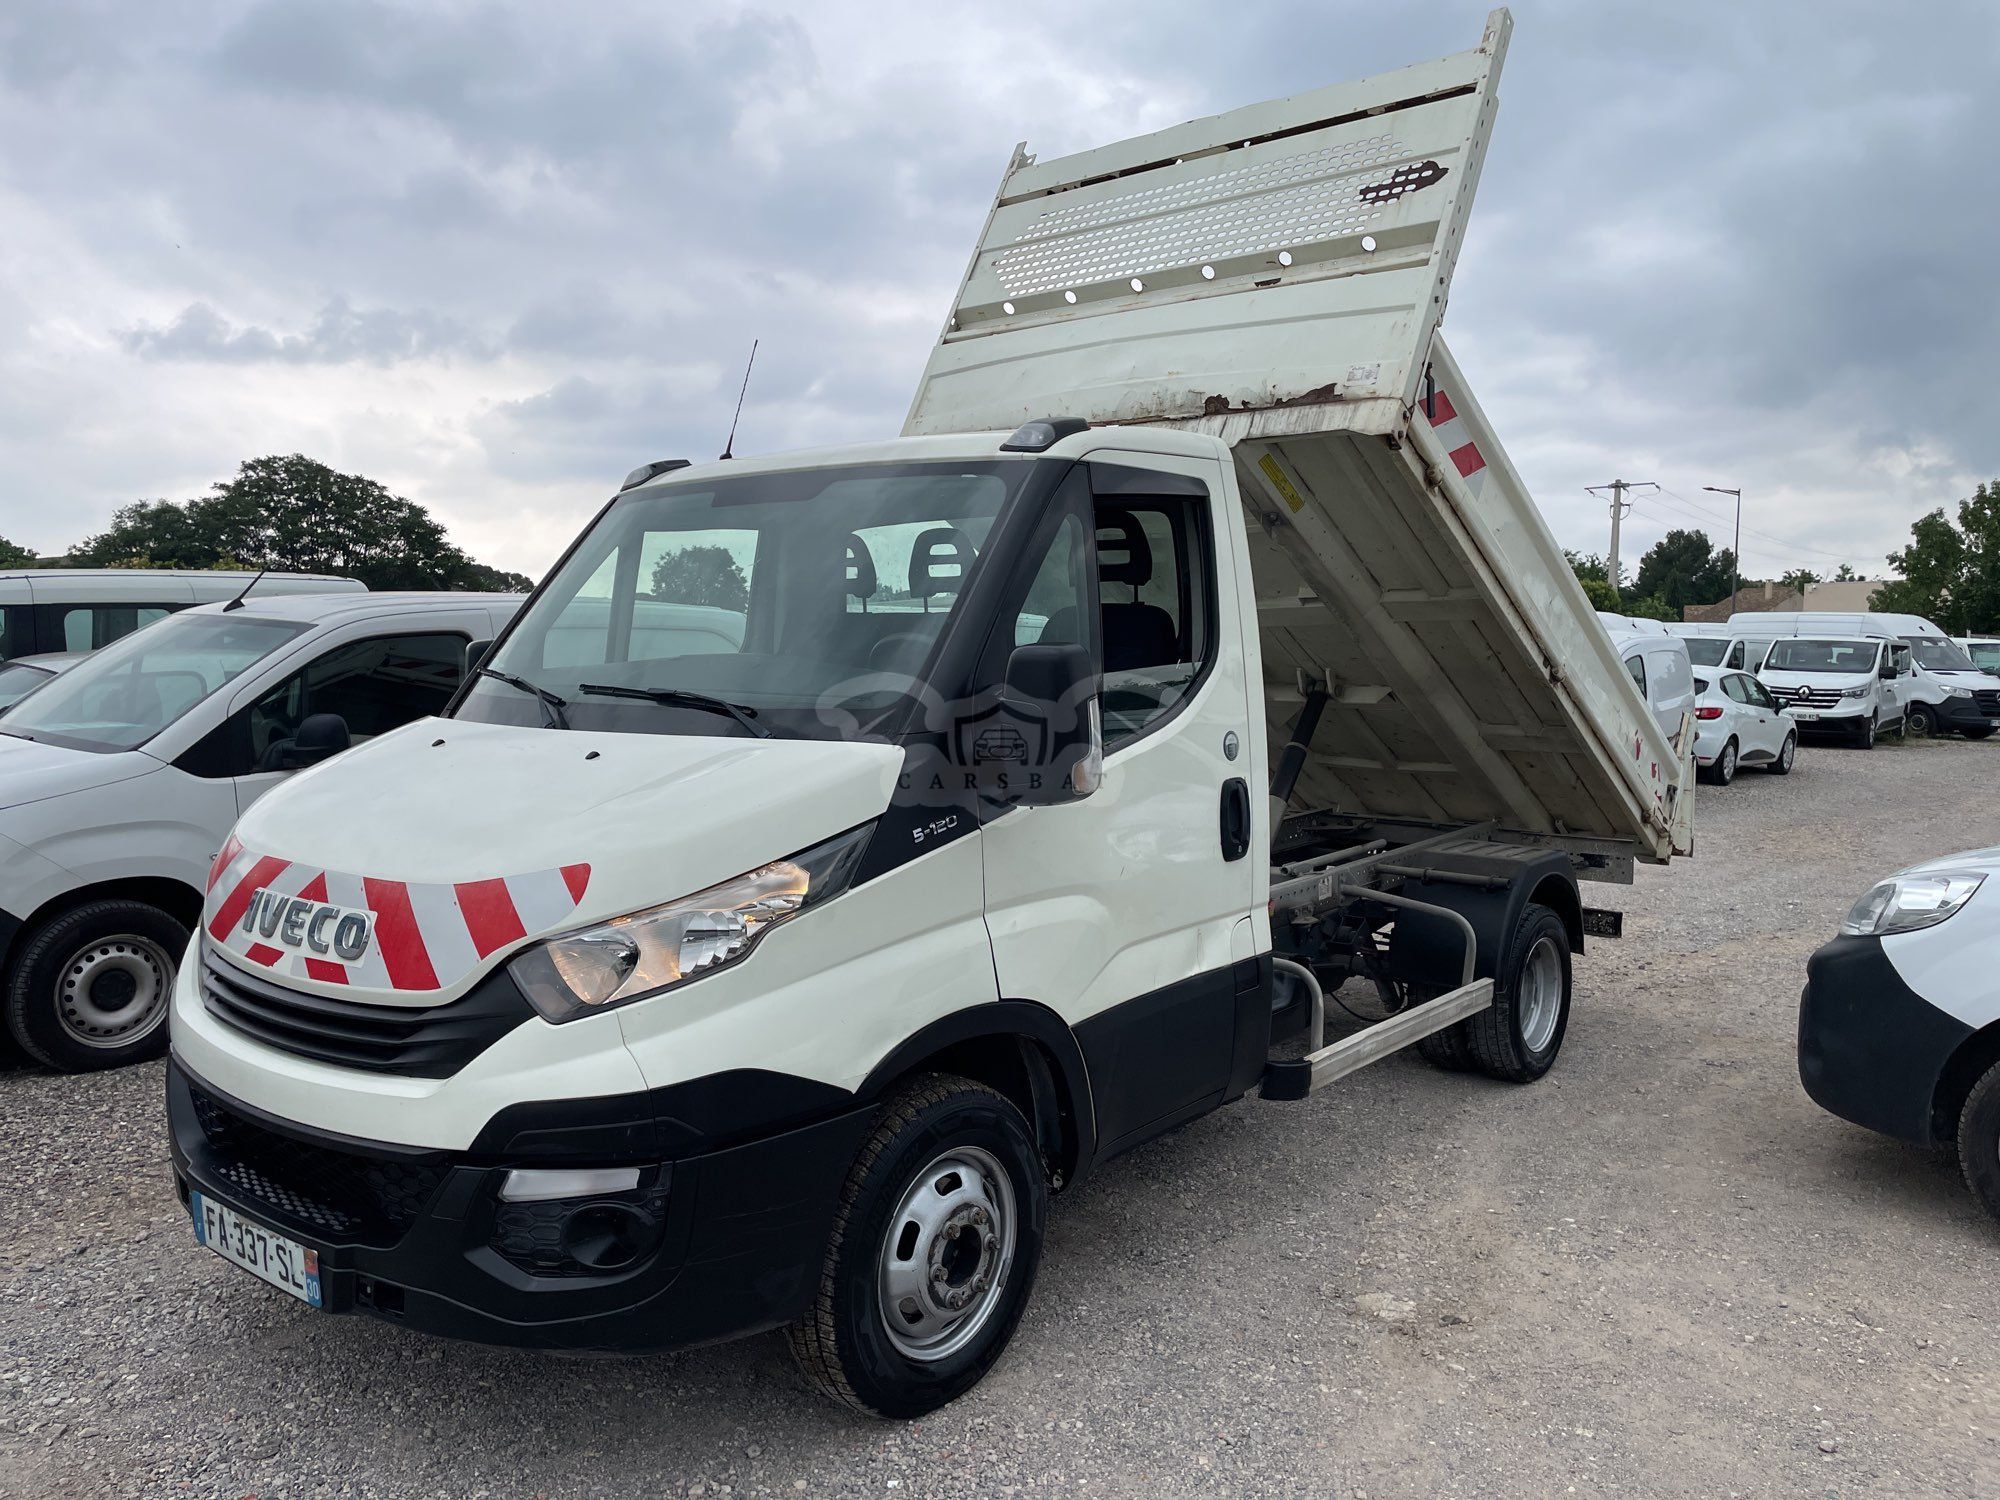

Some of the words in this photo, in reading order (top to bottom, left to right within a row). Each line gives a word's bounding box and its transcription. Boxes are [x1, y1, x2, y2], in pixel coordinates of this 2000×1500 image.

[912, 814, 958, 844] 5-120
[242, 890, 372, 961] IVECO
[306, 1278, 320, 1300] 30
